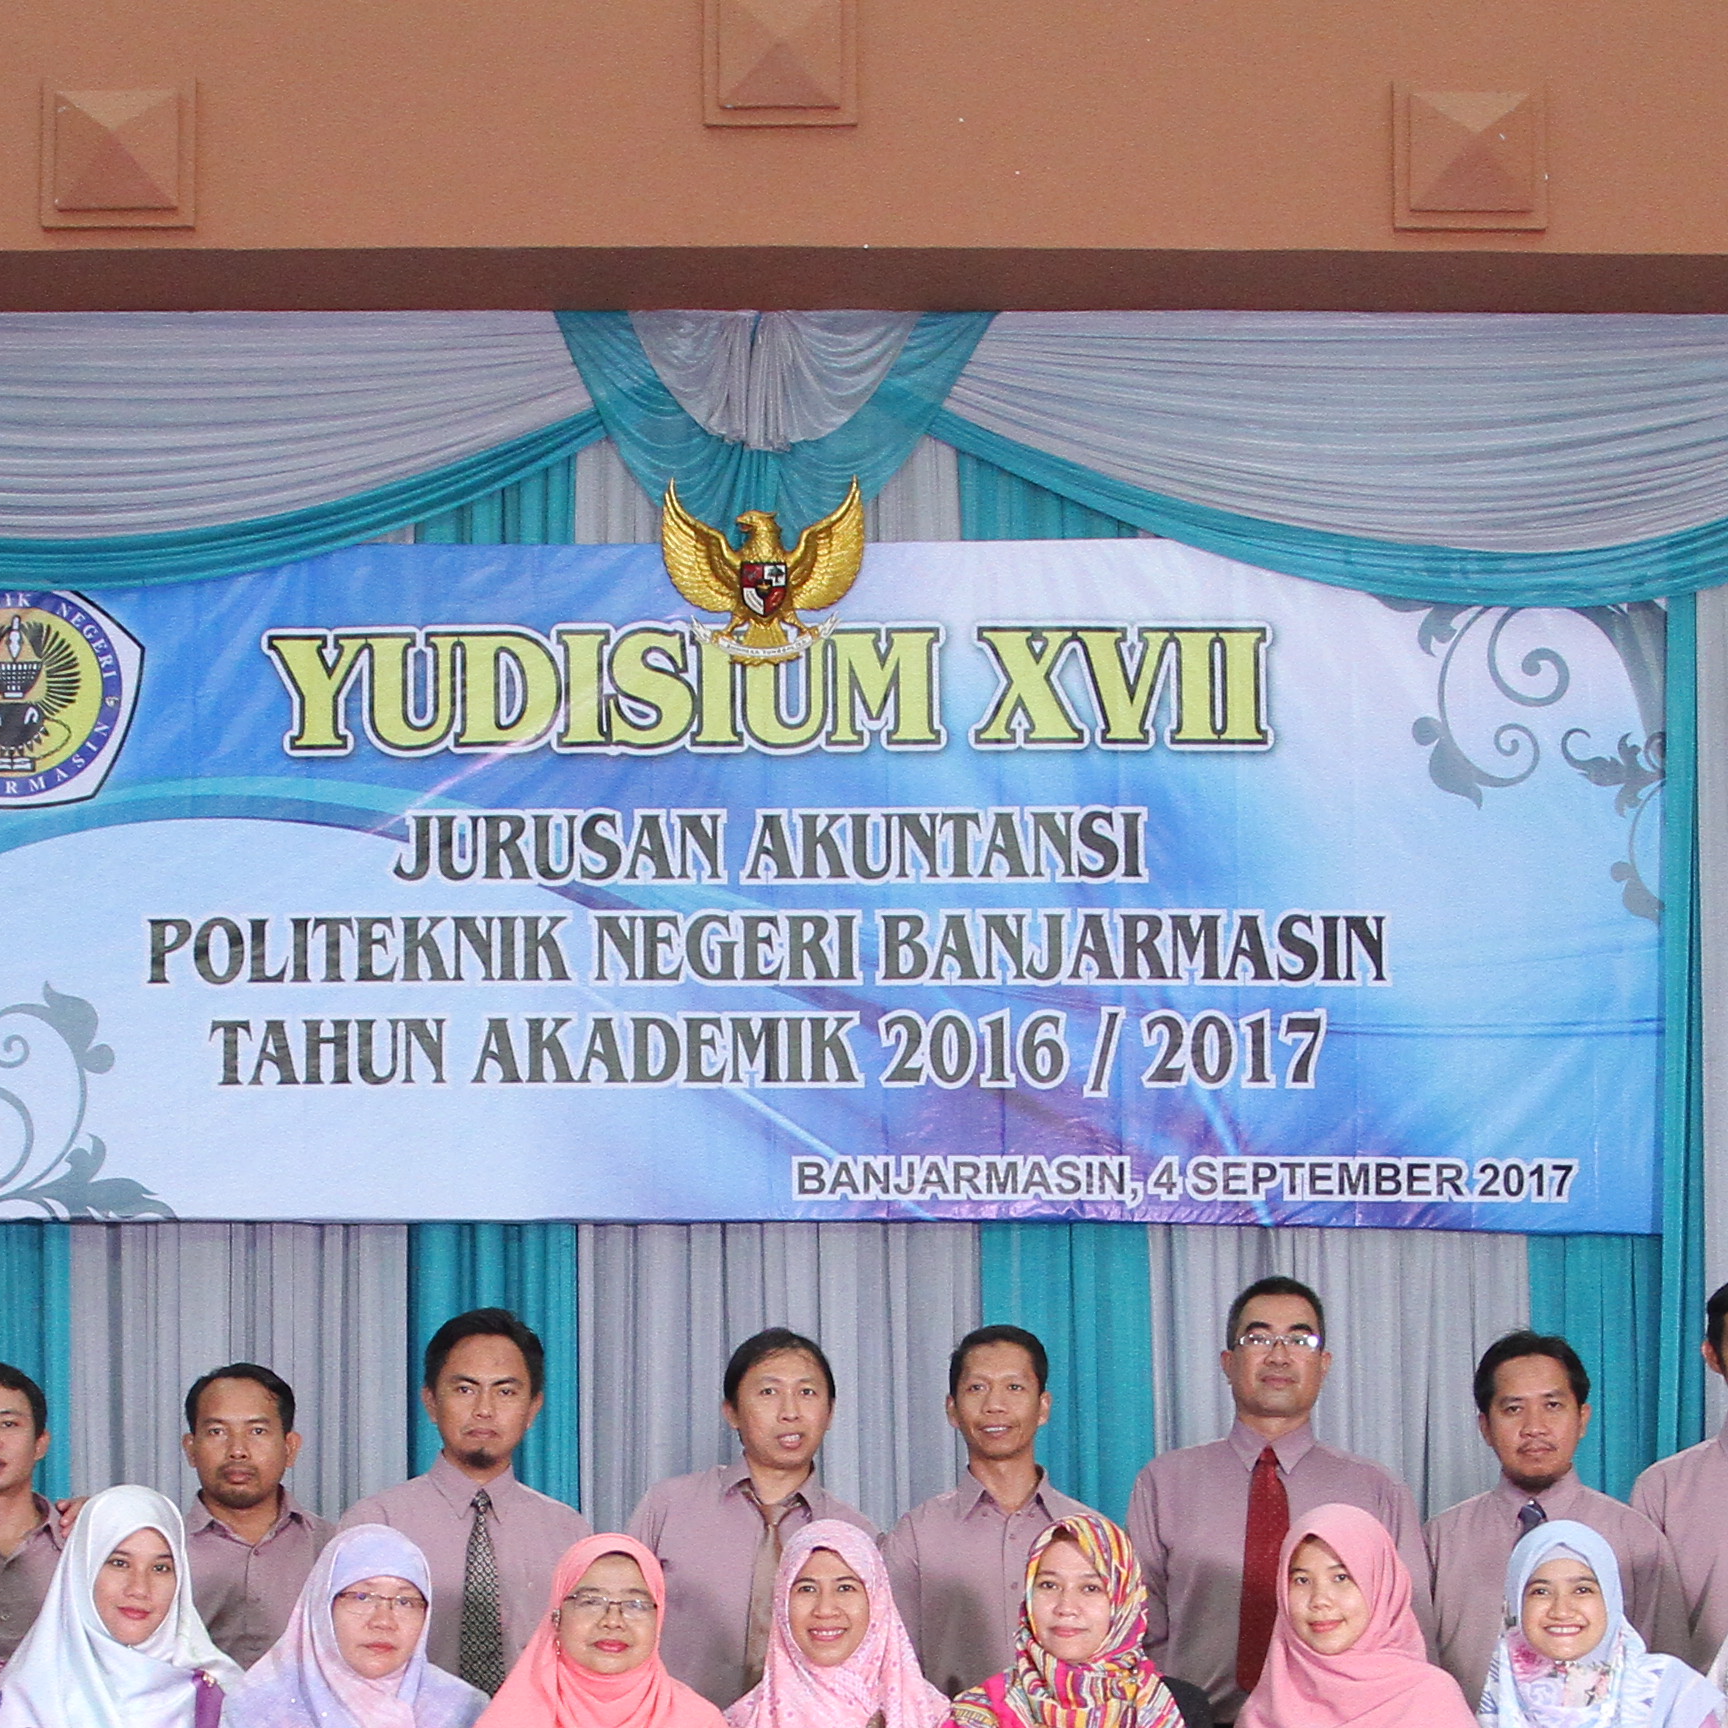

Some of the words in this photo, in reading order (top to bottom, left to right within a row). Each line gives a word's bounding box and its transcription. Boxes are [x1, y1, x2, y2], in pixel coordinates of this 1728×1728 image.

[56, 602, 118, 680] NEGERI
[266, 624, 943, 751] YUDISIUM
[973, 624, 1270, 747] XVII
[392, 812, 724, 882] JURUSAN
[746, 810, 1145, 880] AKUNTANSI
[145, 915, 573, 985] POLITEKNIK
[592, 913, 860, 983] NEGERI
[880, 911, 1387, 983] BANJARMASIN
[208, 1017, 448, 1086] TAHUN
[470, 1016, 860, 1084] AKADEMIK
[882, 1013, 1063, 1085] 2016
[1088, 1010, 1120, 1094] /
[1144, 1011, 1325, 1086] 2017
[796, 1159, 1140, 1201] BANJARMASIN,
[1152, 1160, 1177, 1195] 4
[1191, 1160, 1463, 1197] SEPTEMBER
[1477, 1162, 1574, 1198] 2017
